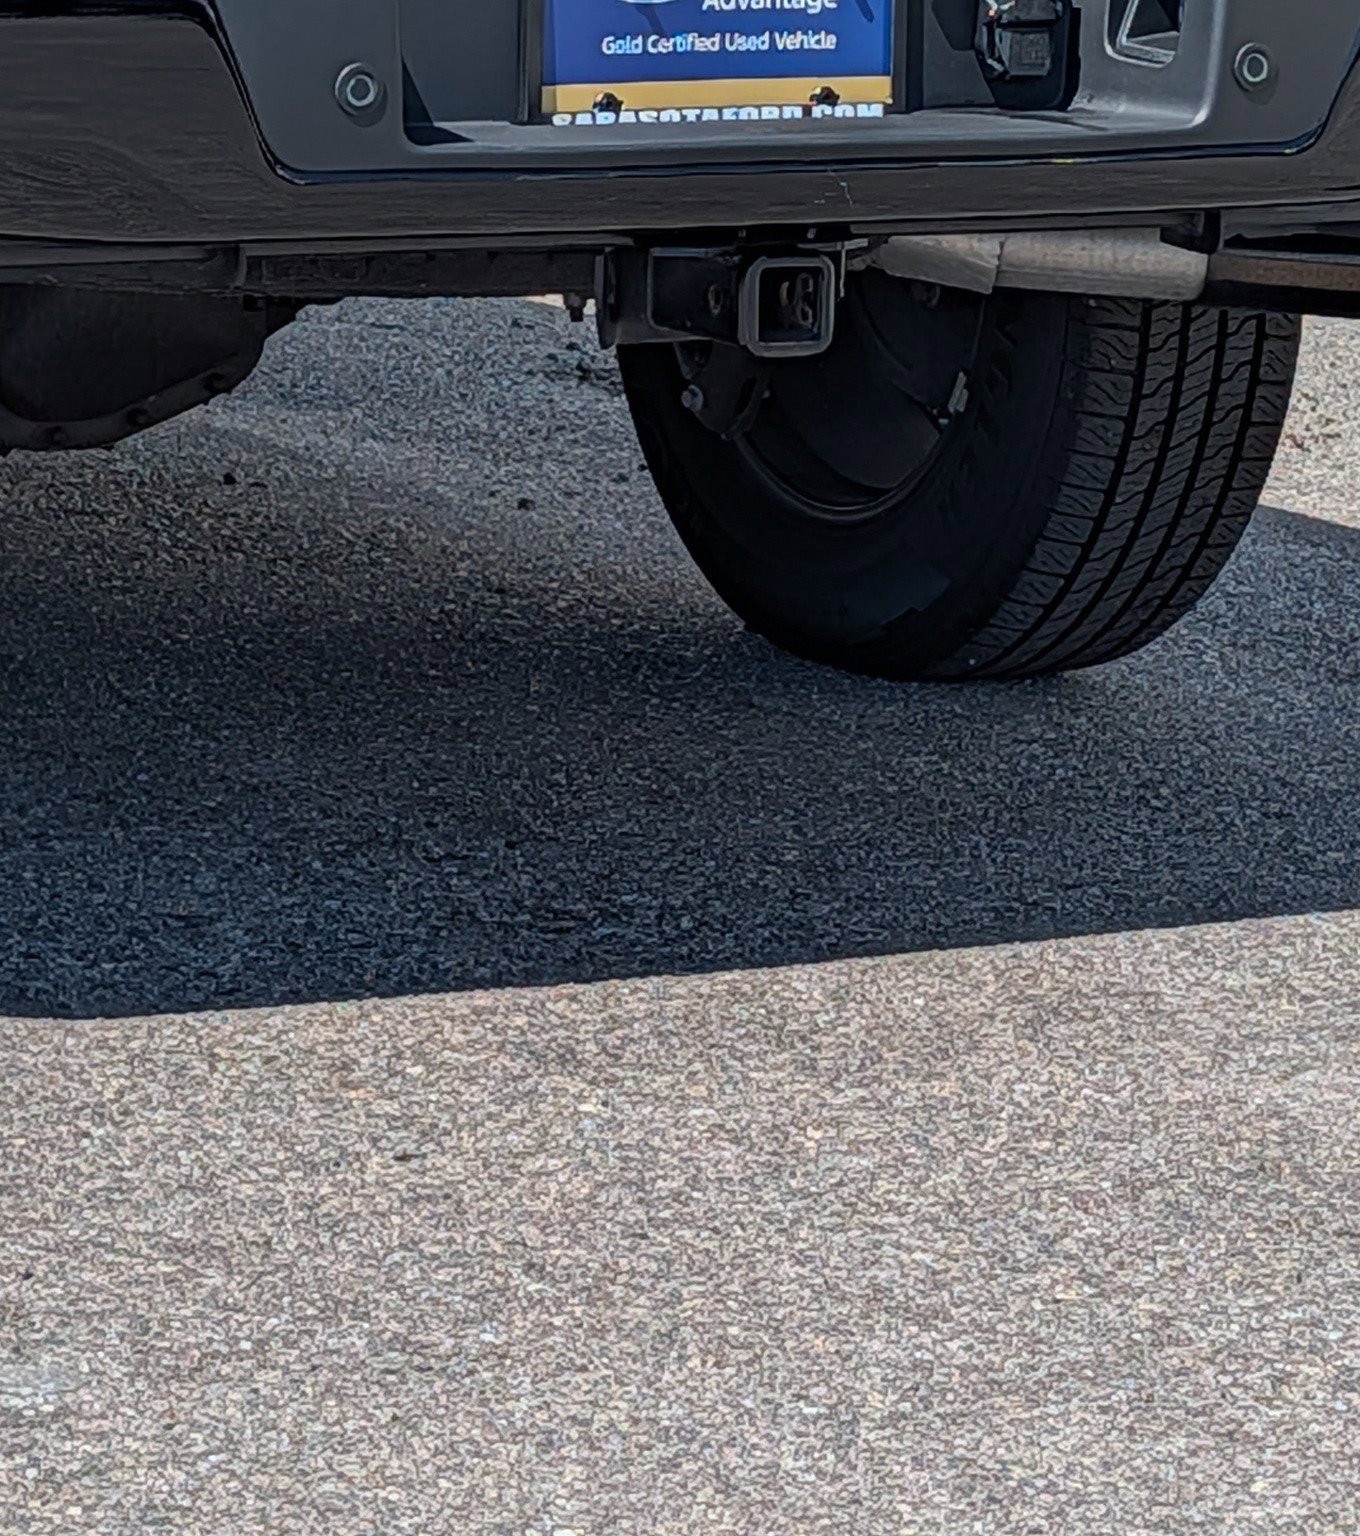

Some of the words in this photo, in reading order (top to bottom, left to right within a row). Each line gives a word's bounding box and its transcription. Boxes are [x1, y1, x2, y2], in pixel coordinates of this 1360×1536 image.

[601, 34, 643, 55] Gold
[647, 32, 721, 55] Certified
[725, 31, 770, 52] Used
[774, 29, 838, 51] Vehicle
